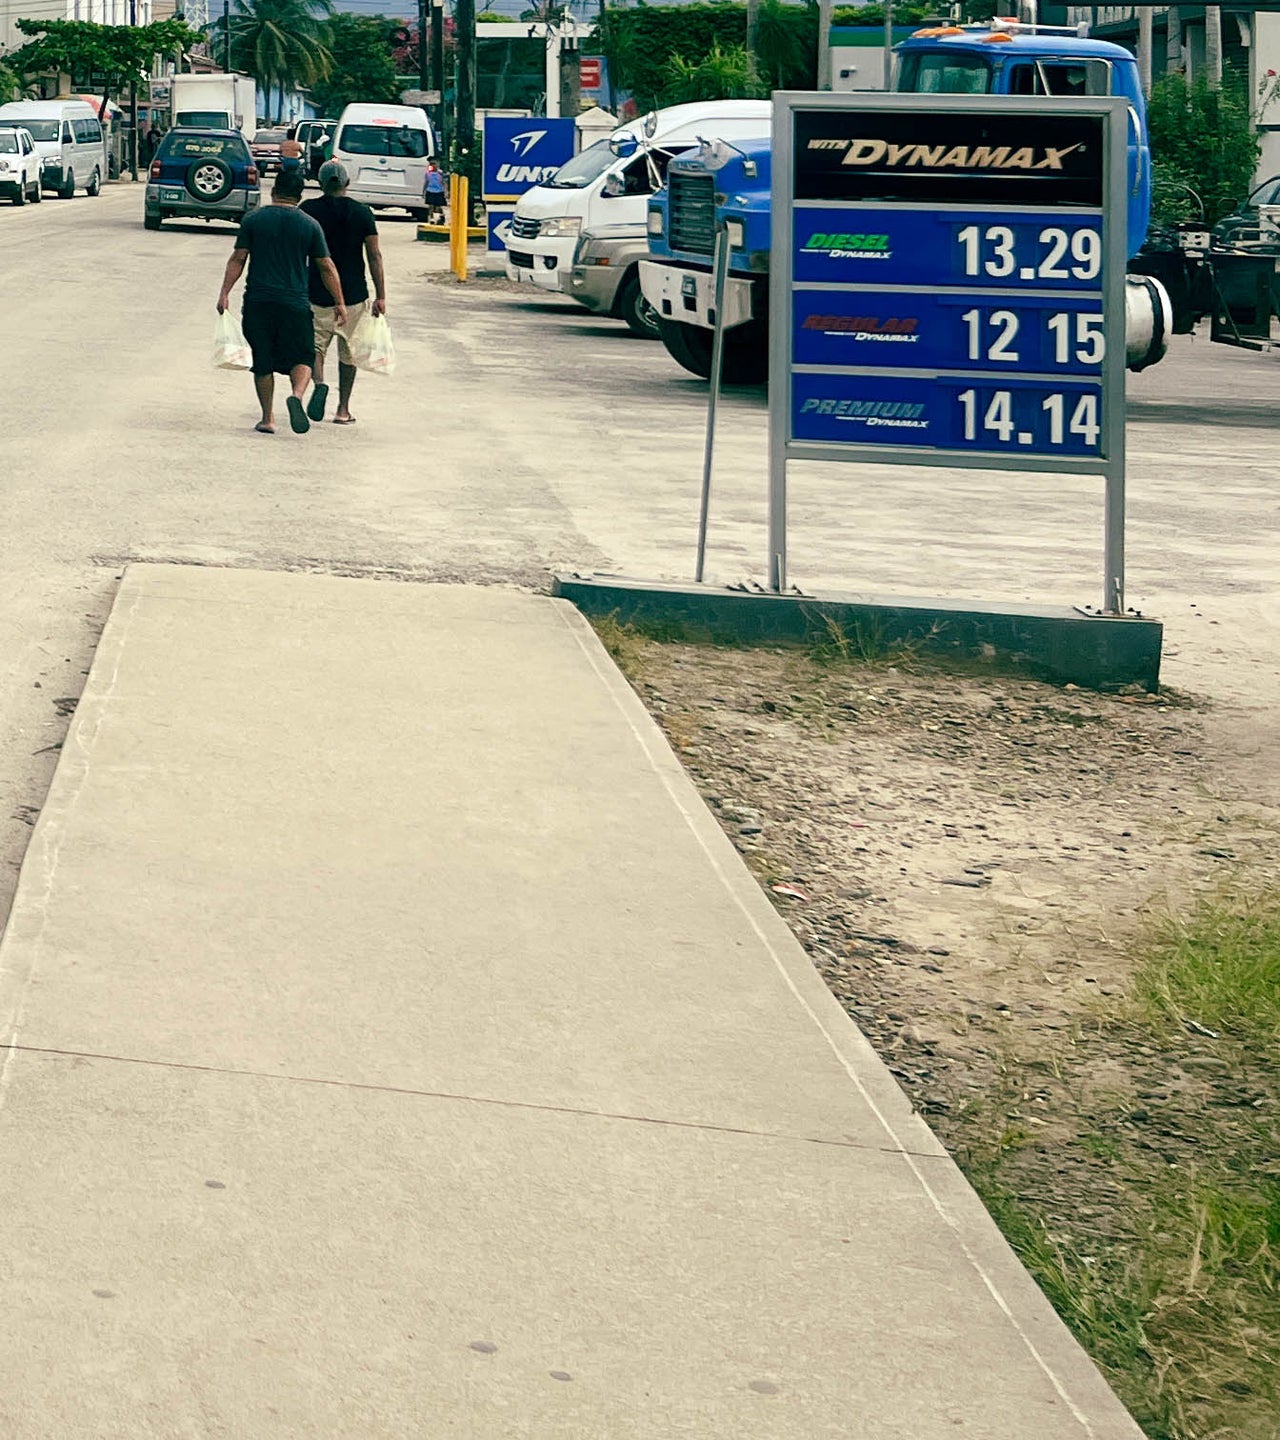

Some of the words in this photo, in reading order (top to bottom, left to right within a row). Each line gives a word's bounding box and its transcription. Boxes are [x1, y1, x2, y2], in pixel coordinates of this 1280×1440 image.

[807, 139, 850, 150] WITH
[841, 138, 1084, 170] DYNAMAX
[805, 233, 889, 250] DIESEL
[958, 225, 1102, 280] 13.29
[829, 249, 894, 259] DYNAMAX
[802, 315, 918, 333] REGULAR
[855, 332, 920, 342] DYNAMAX
[800, 399, 925, 418] PREMIUM
[958, 389, 1101, 446] 14.14
[866, 417, 930, 429] DYNAMAX
